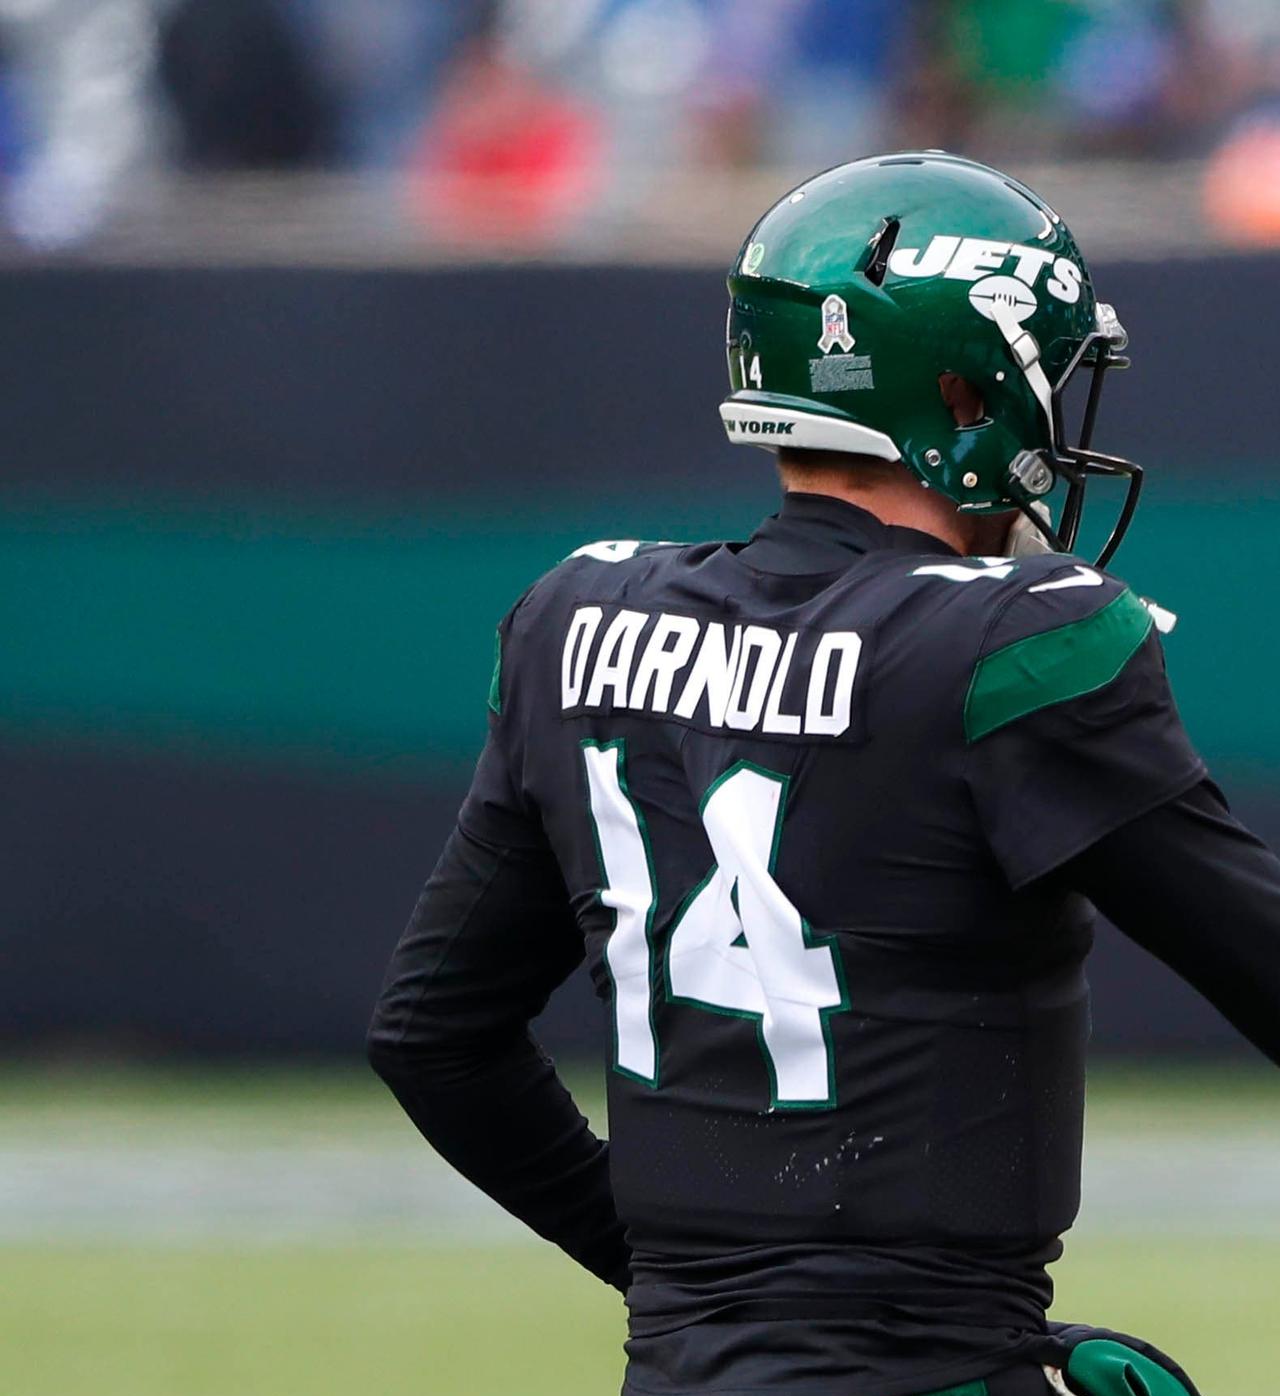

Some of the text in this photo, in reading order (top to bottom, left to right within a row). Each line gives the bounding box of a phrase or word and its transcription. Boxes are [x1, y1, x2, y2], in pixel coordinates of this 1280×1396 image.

[890, 235, 1082, 304] JETS
[739, 354, 763, 389] 14
[740, 421, 796, 434] YORK
[561, 606, 863, 738] DARNOLD
[579, 738, 852, 1110] 14
